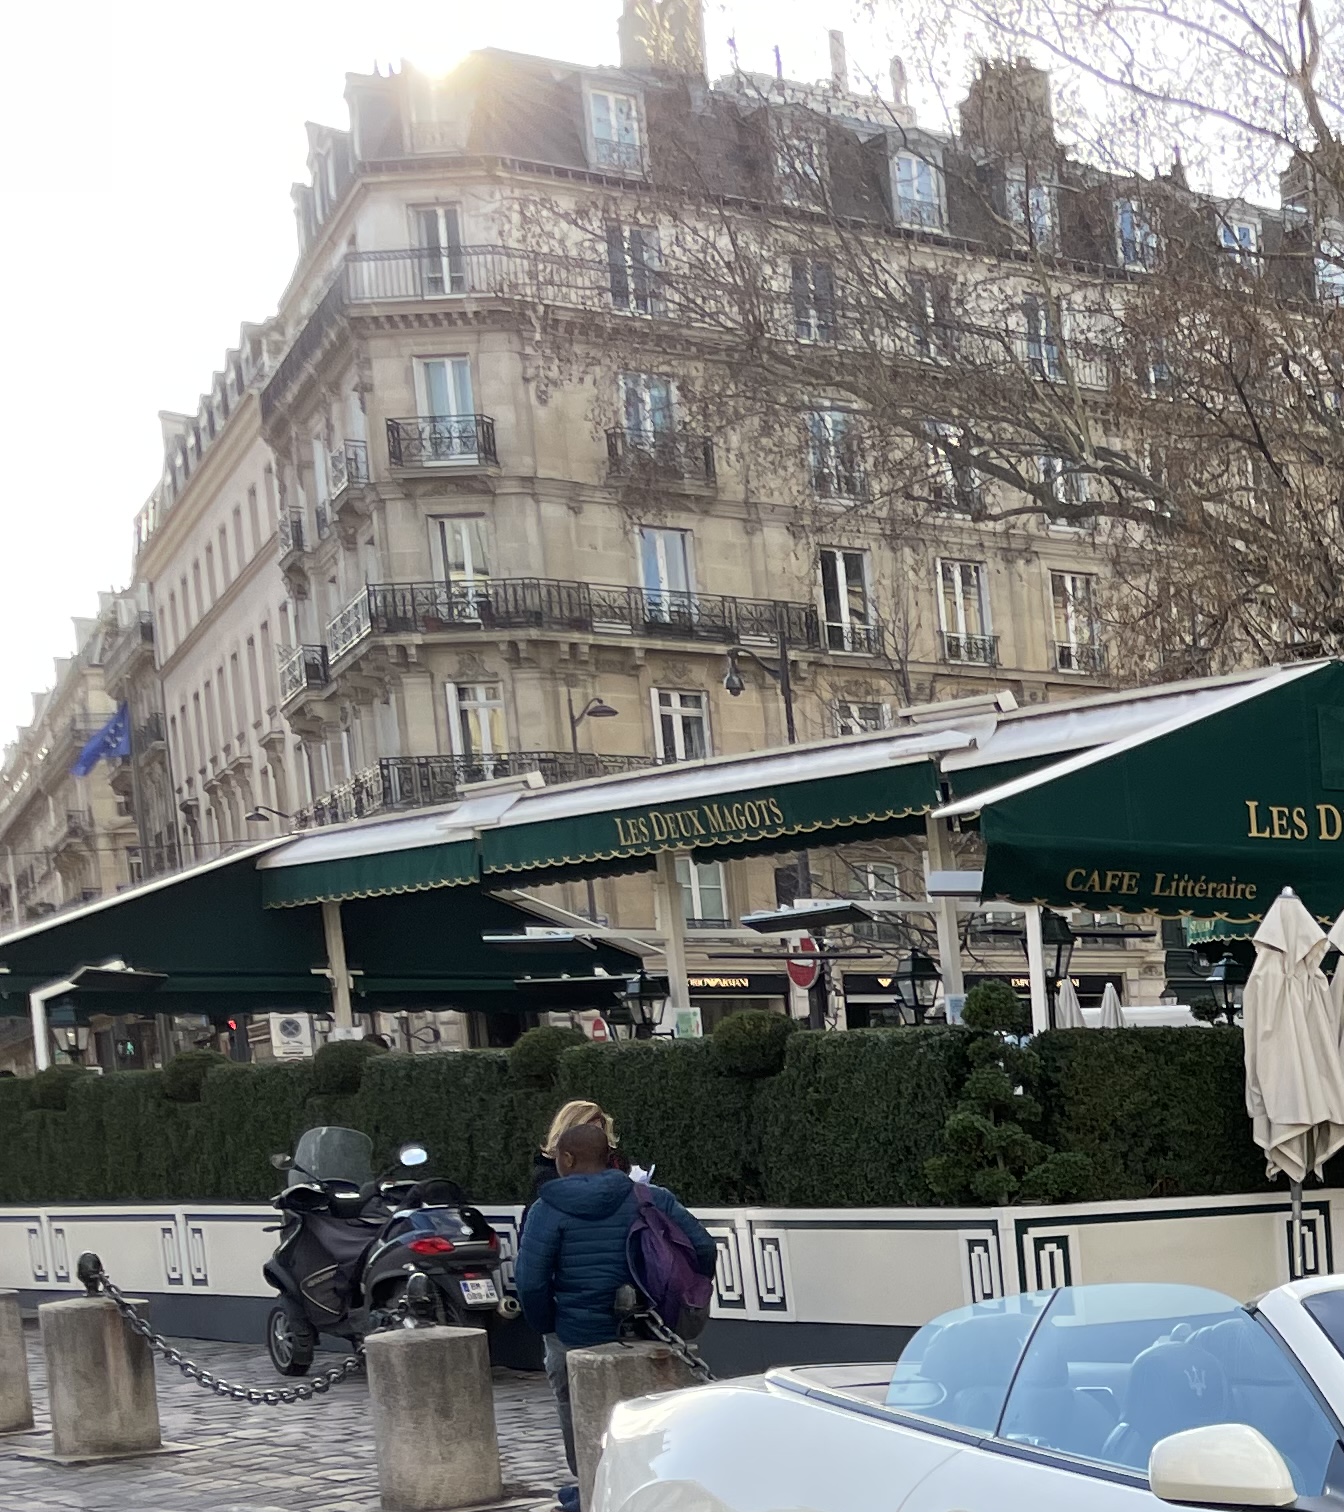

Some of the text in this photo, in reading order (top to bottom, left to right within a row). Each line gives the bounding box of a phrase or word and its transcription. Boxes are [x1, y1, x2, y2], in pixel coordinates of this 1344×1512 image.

[614, 798, 784, 846] LES DEUX MAGOTS
[1245, 800, 1309, 840] LES
[1065, 868, 1257, 900] CAFE Littéraire
